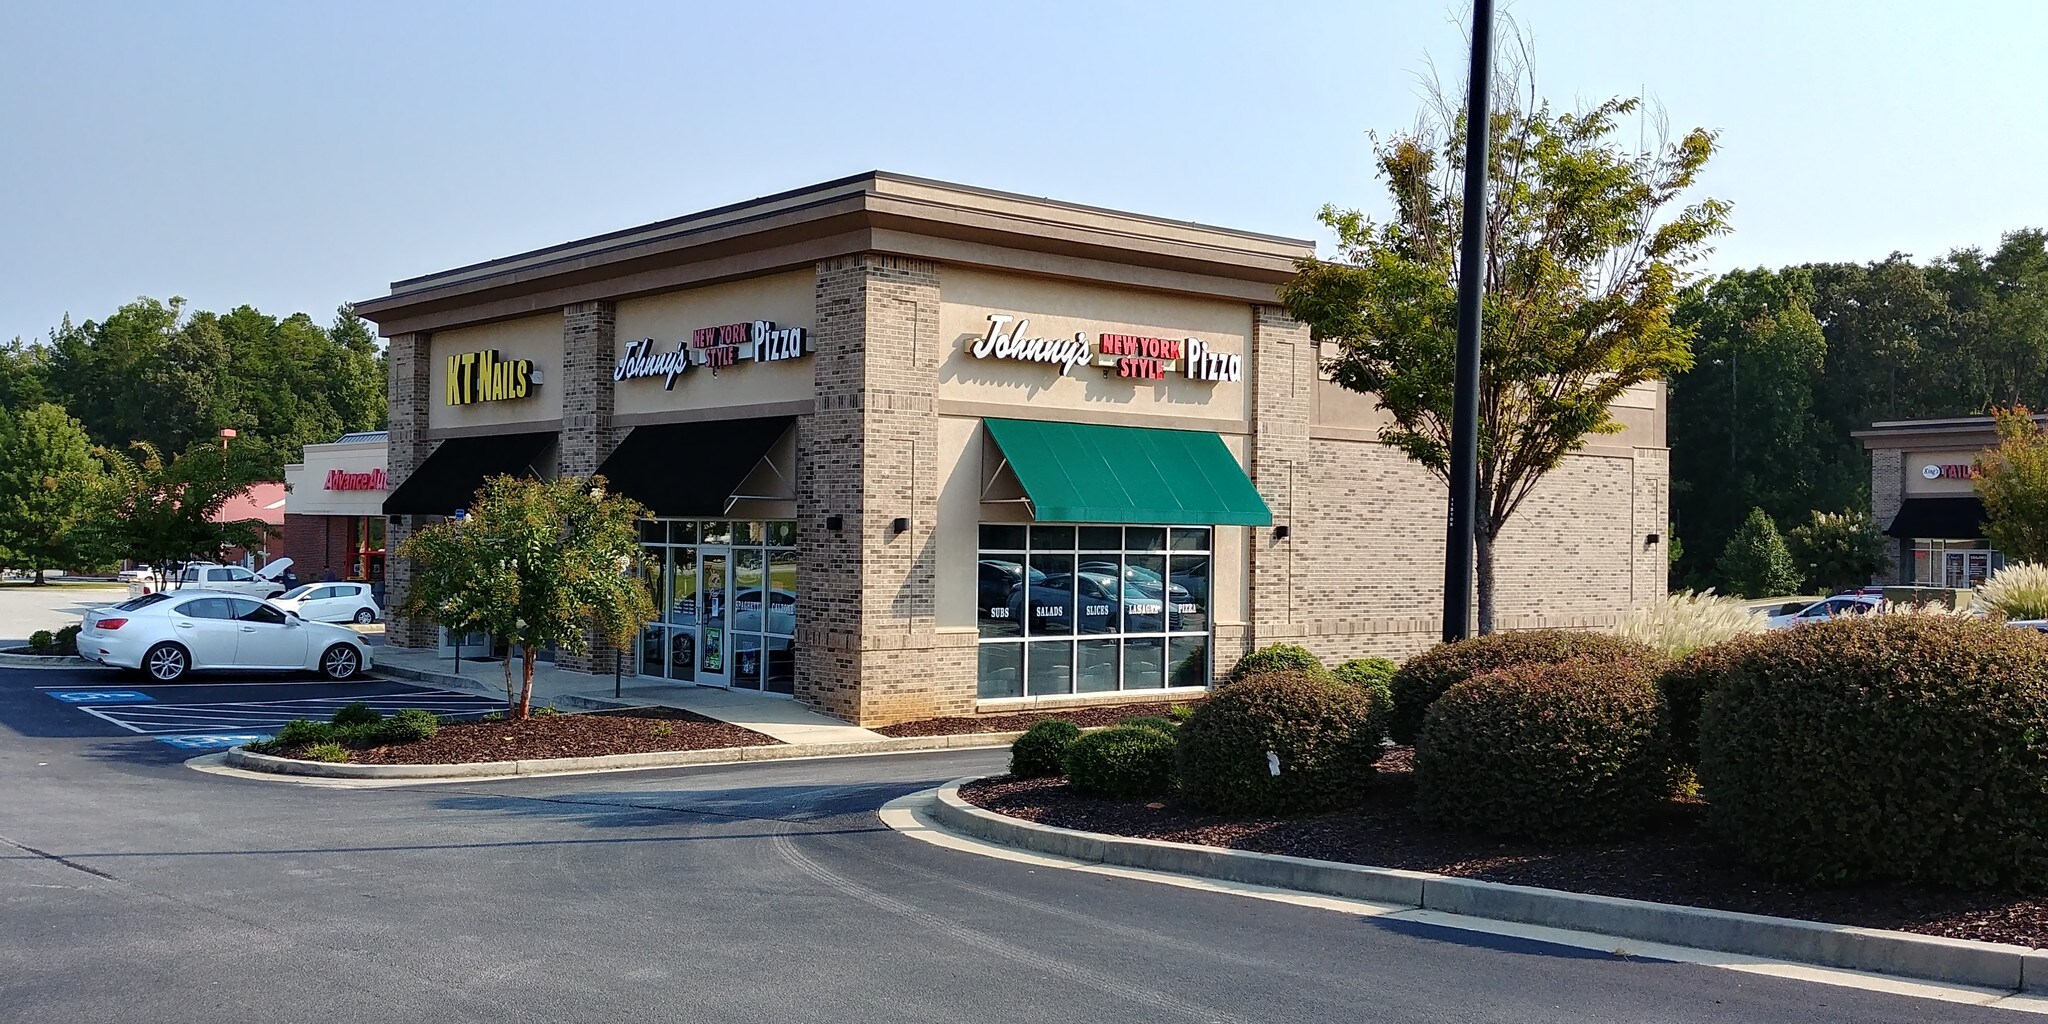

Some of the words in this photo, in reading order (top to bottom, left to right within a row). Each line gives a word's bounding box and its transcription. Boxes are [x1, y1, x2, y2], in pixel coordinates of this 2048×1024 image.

[693, 327, 717, 348] NEW
[719, 323, 748, 344] YORK
[754, 320, 802, 363] Pizza
[970, 314, 1093, 377] Johnny's
[1101, 334, 1137, 355] NEW
[1140, 337, 1182, 360] YORK
[613, 338, 690, 391] Johnny's
[705, 346, 735, 368] STYLE
[1186, 337, 1242, 382] Pizza
[447, 353, 476, 405] KT
[1118, 358, 1165, 380] STYLE
[323, 469, 370, 490] Advance
[990, 607, 1010, 618] SUBS
[1036, 606, 1063, 617] SALADS
[1086, 605, 1109, 616] SLICES
[1178, 603, 1197, 614] PIZZA
